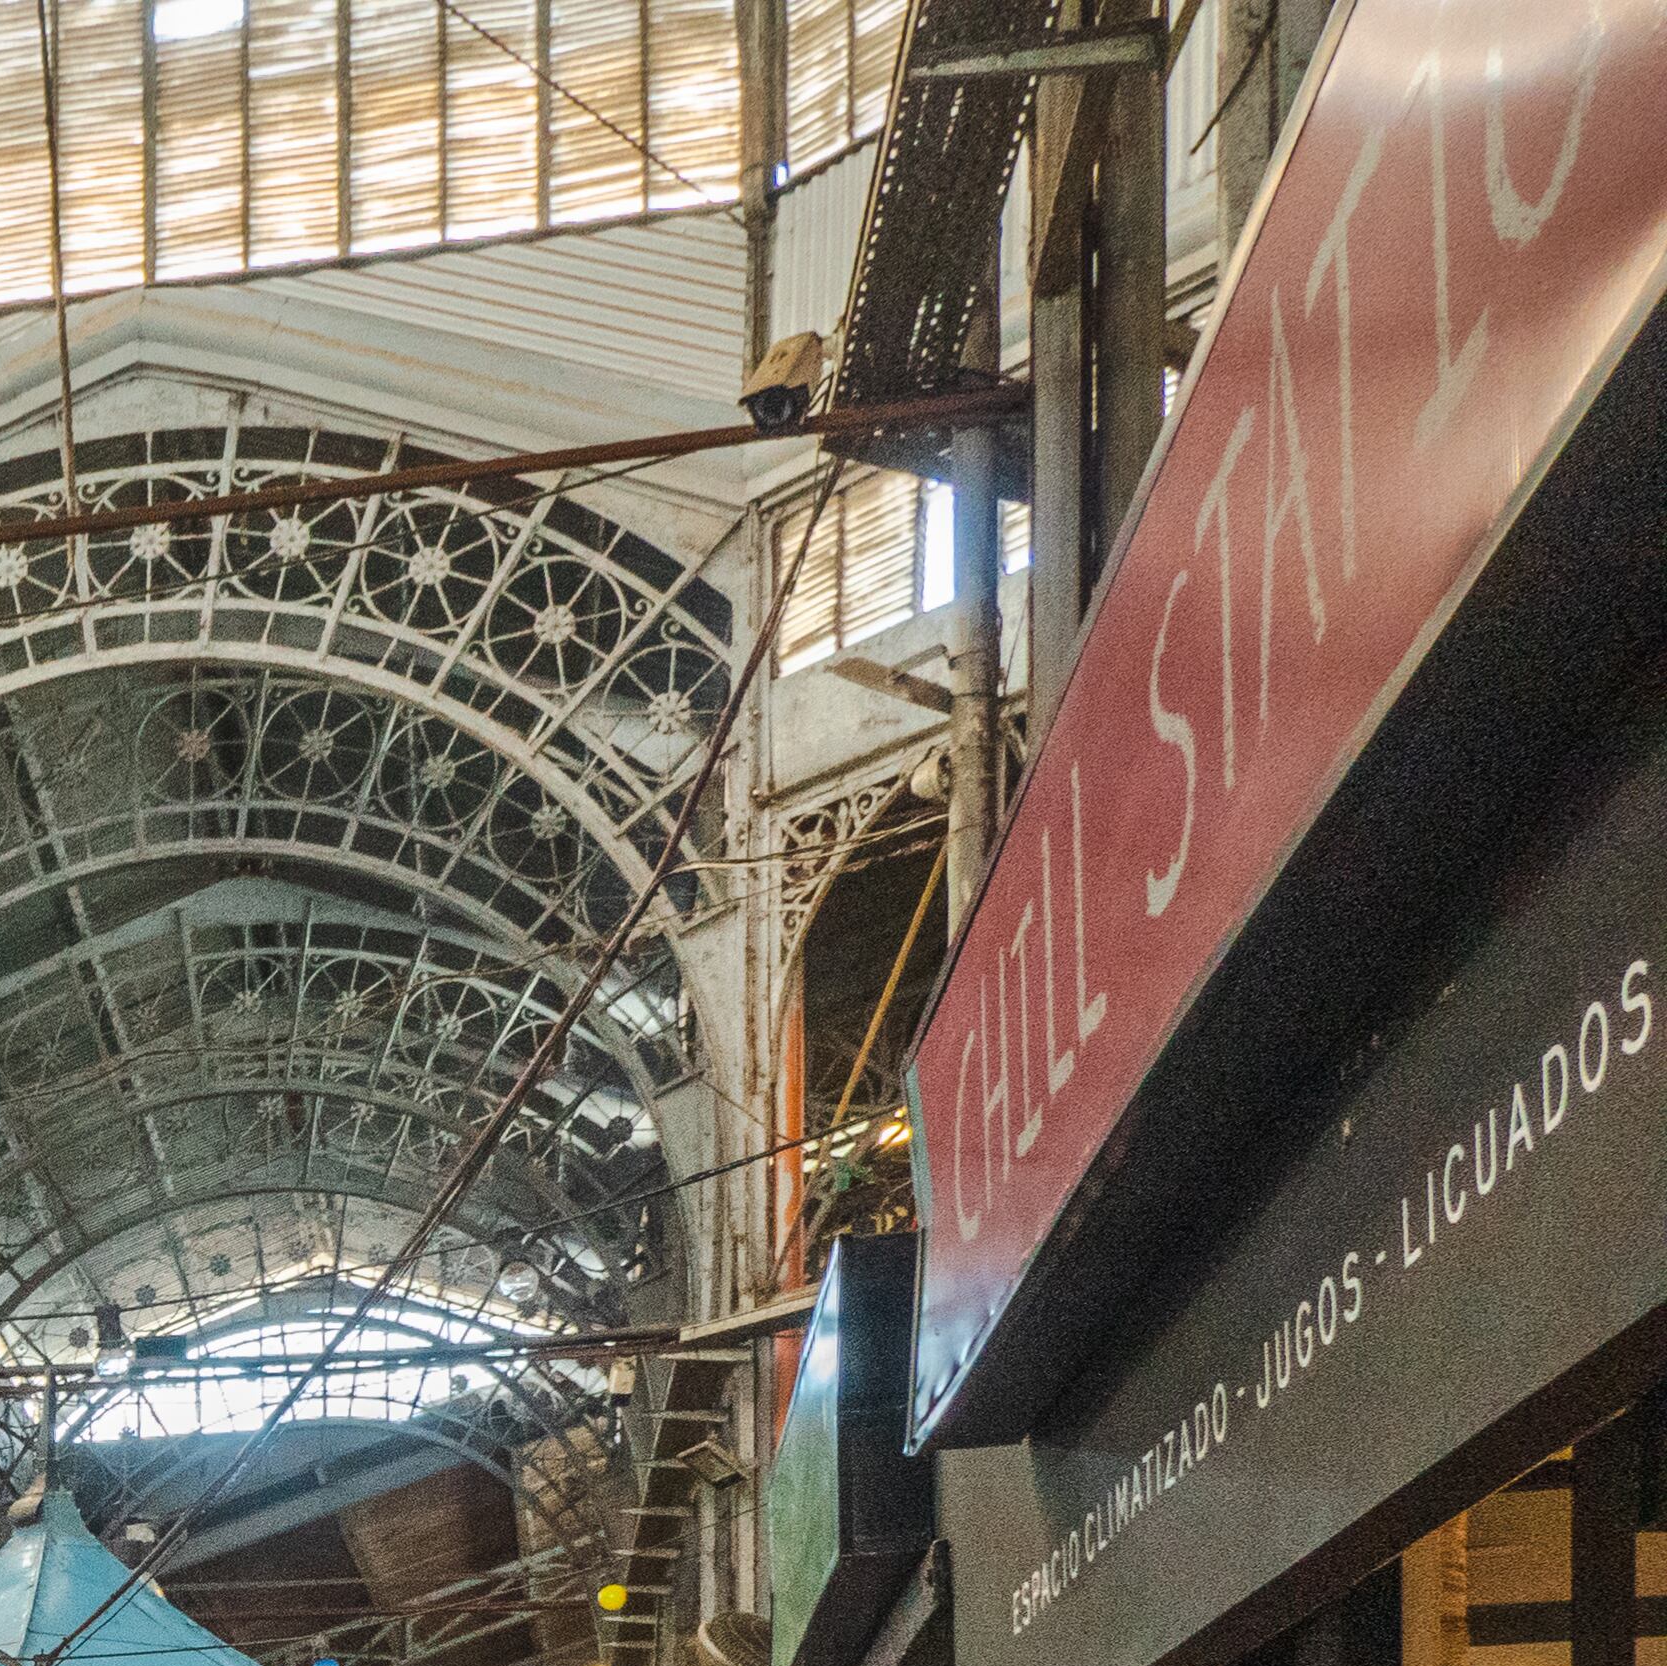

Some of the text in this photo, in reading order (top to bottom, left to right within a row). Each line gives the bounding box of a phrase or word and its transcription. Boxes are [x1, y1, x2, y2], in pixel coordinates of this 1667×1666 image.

[953, 0, 1665, 1243] CHILL STATIO
[1011, 958, 1653, 1635] ESPACIO CLIMATIZADO JUGOS LICUADOS
